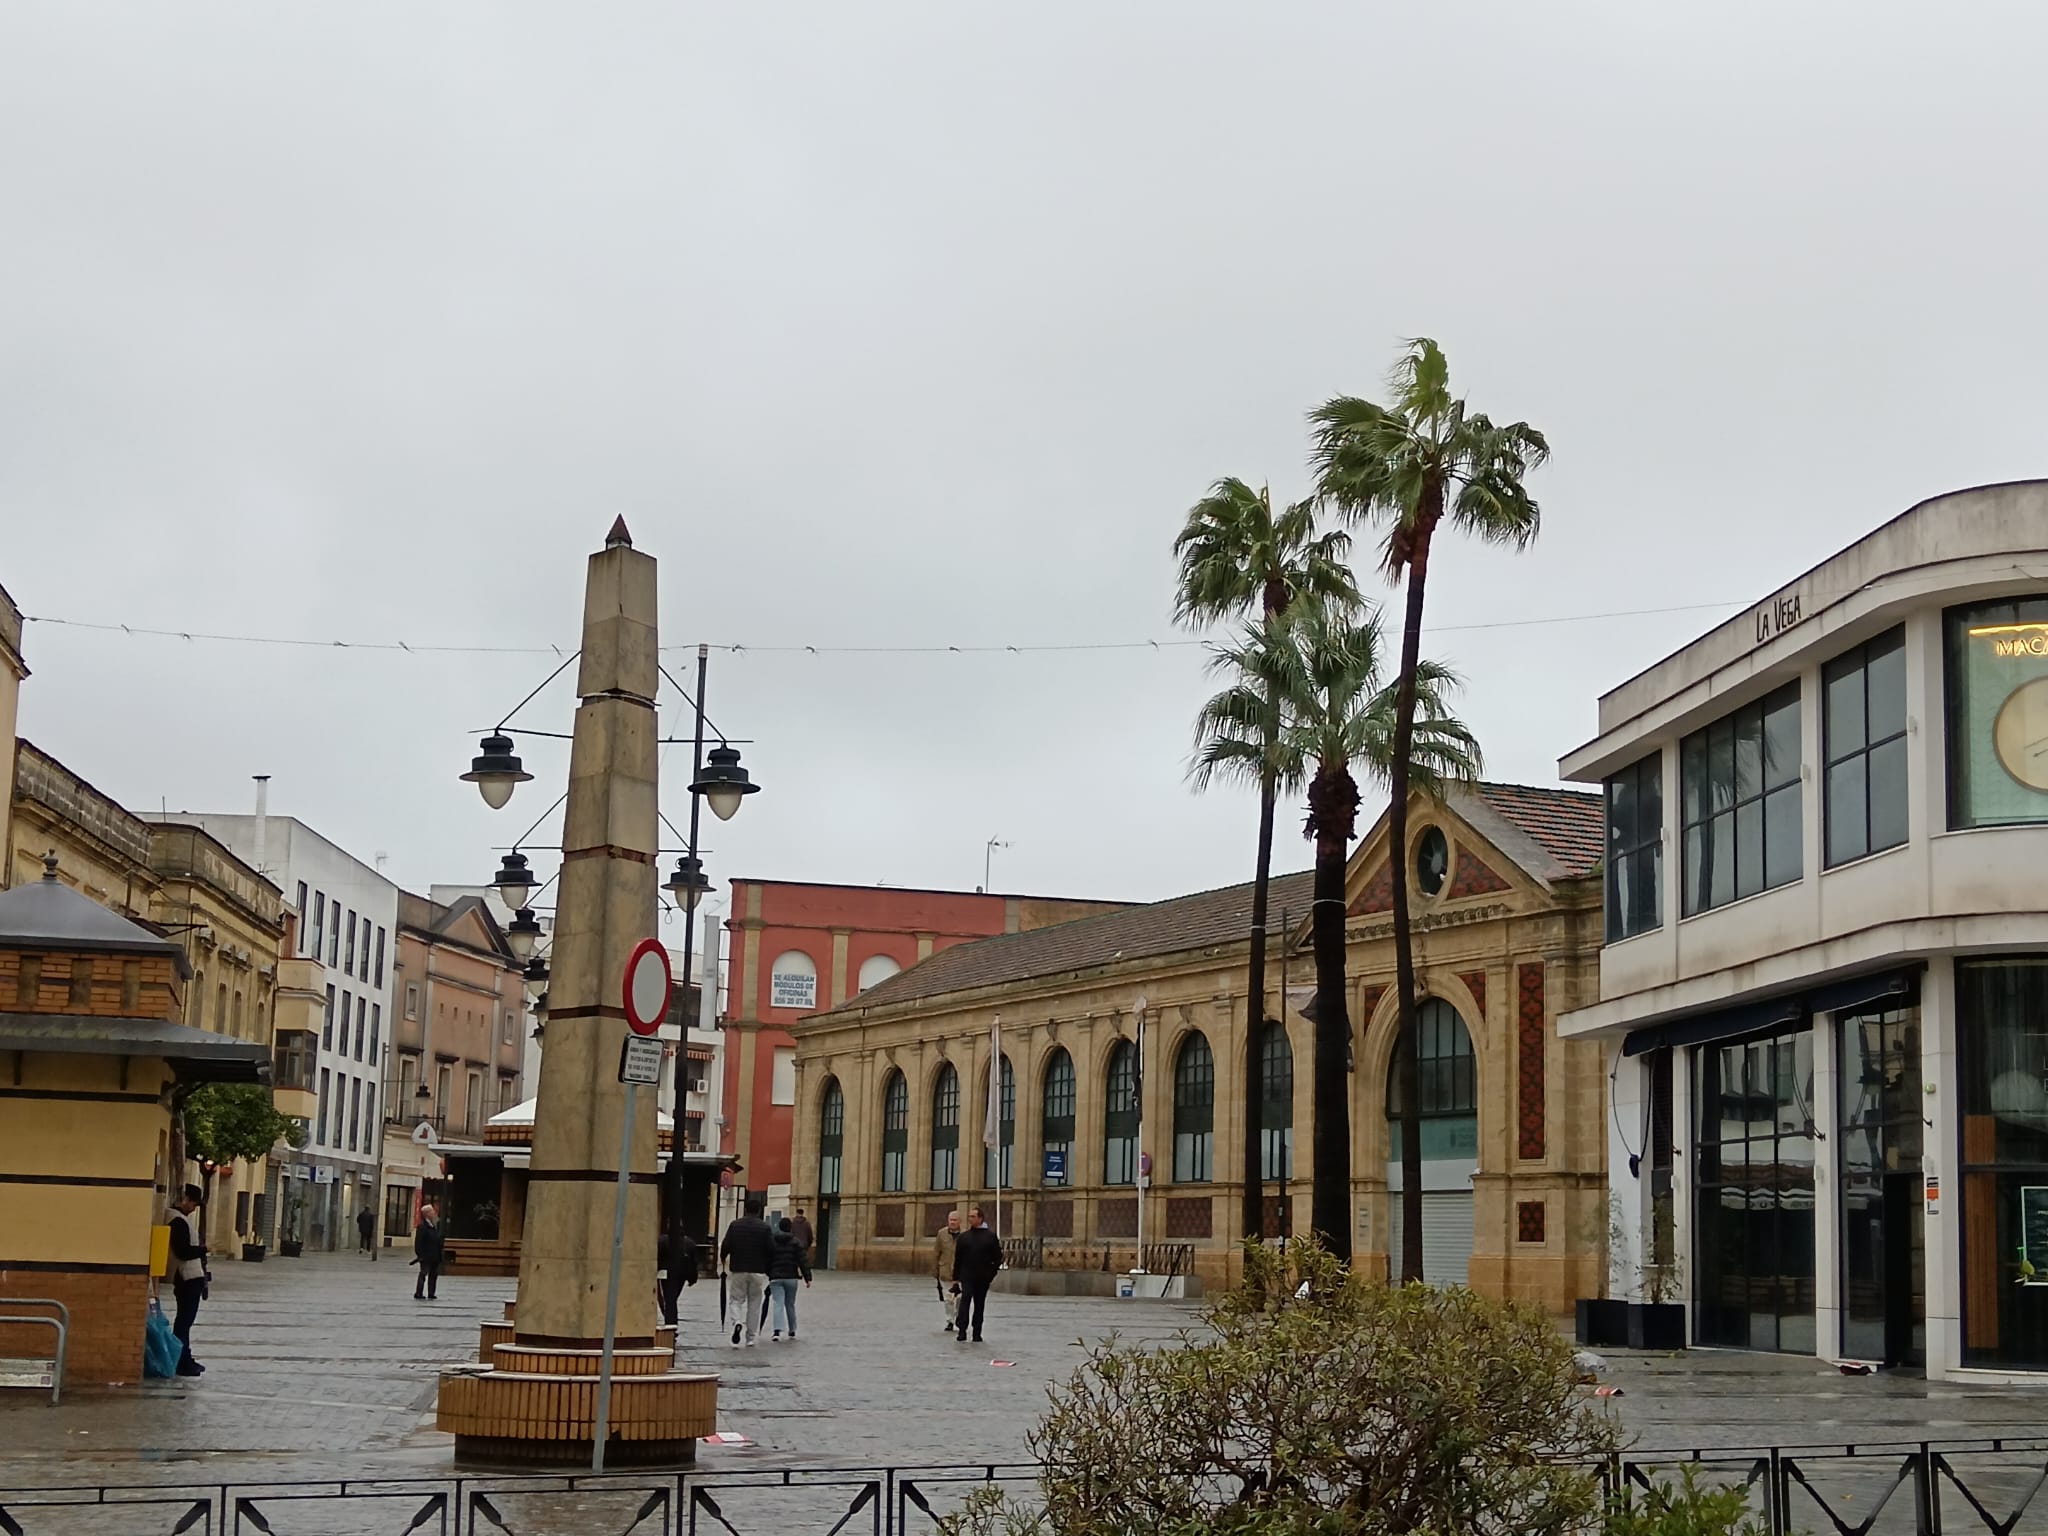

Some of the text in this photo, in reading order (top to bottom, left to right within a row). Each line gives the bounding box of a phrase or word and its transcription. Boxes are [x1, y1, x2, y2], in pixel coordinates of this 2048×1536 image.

[1757, 595, 1801, 643] LA VEGA
[783, 974, 815, 983] ALQUILAN
